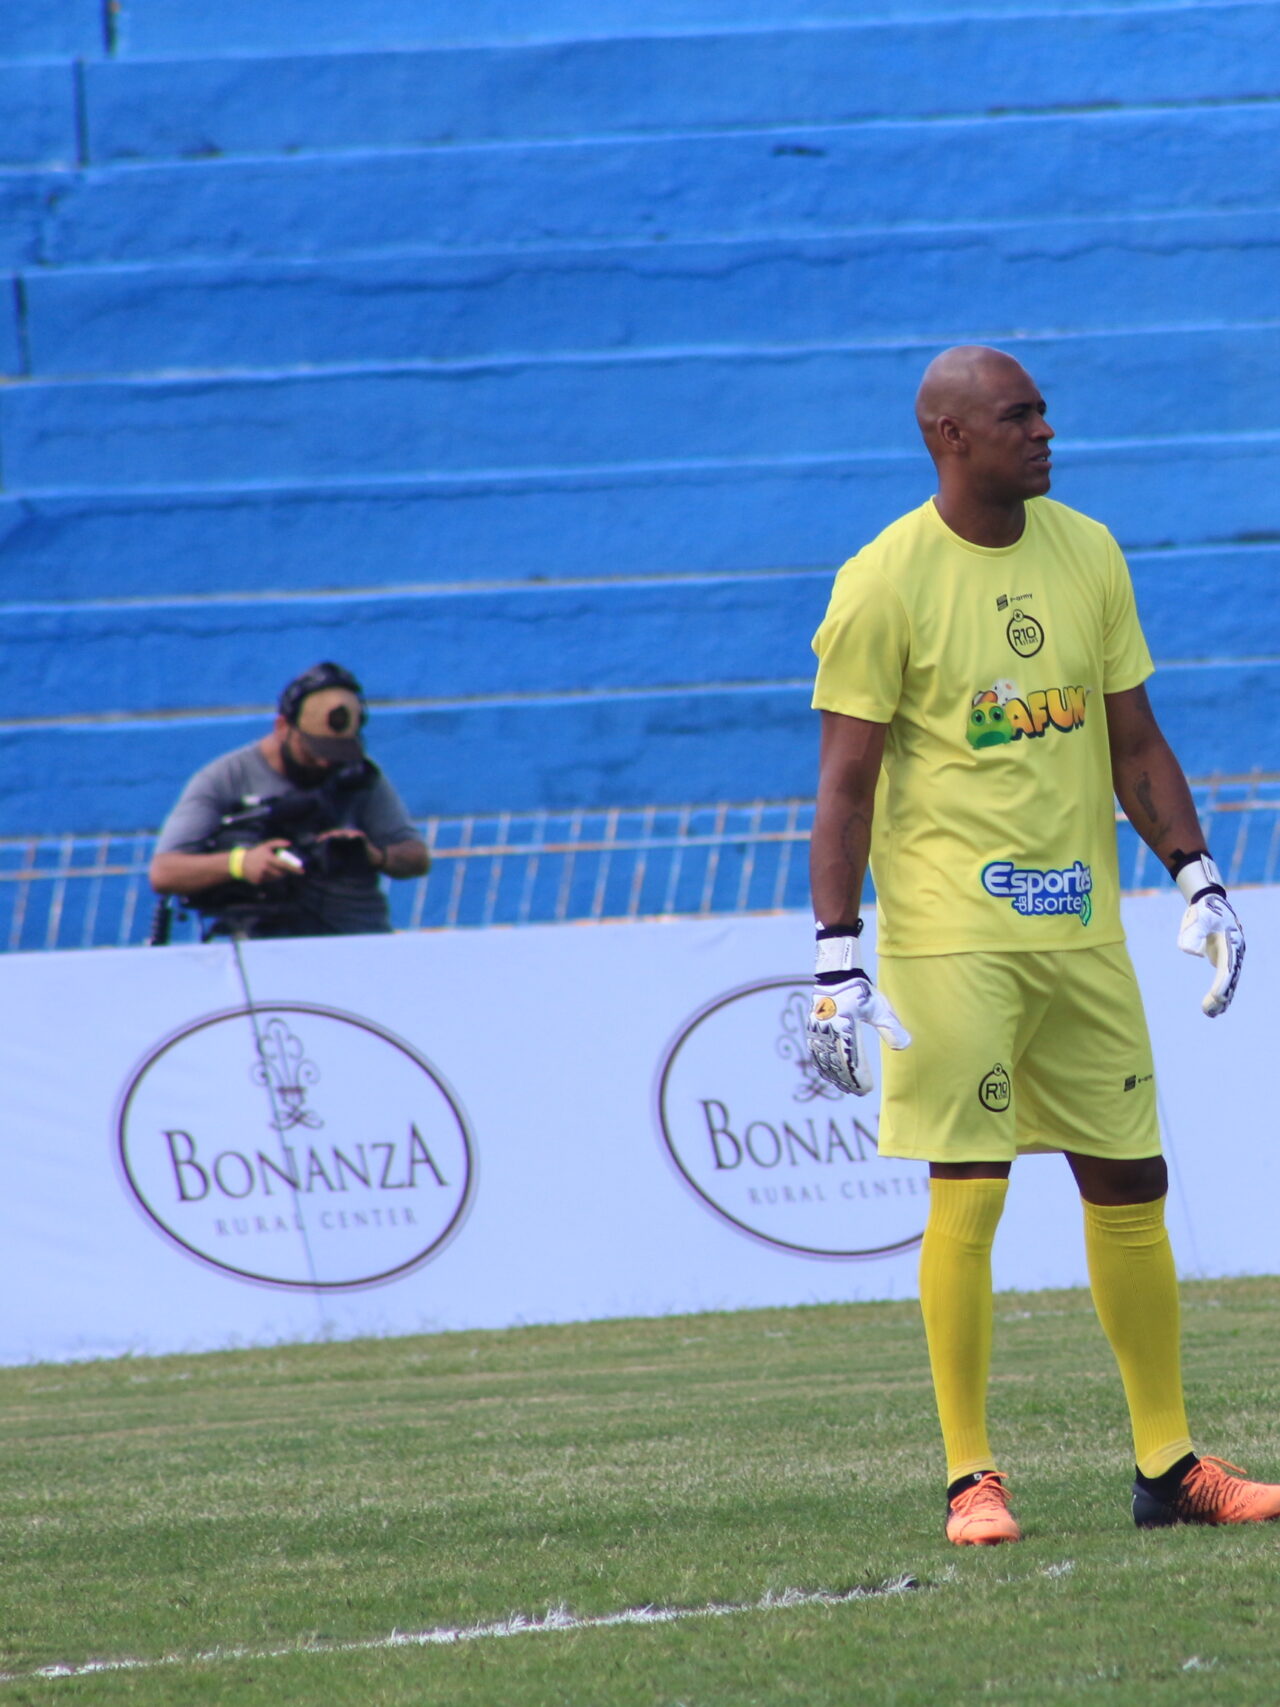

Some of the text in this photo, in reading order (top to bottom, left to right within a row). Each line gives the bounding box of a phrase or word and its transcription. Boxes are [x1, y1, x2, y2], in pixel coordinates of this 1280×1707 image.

[1012, 626, 1036, 646] R10
[1005, 685, 1086, 741] AFUN
[1034, 894, 1082, 912] sorte
[985, 1081, 1008, 1100] R10
[700, 1099, 882, 1170] BONAN
[161, 1121, 450, 1202] BONANZA
[749, 1184, 826, 1205] RURAL
[214, 1207, 418, 1237] RURAL CENTER
